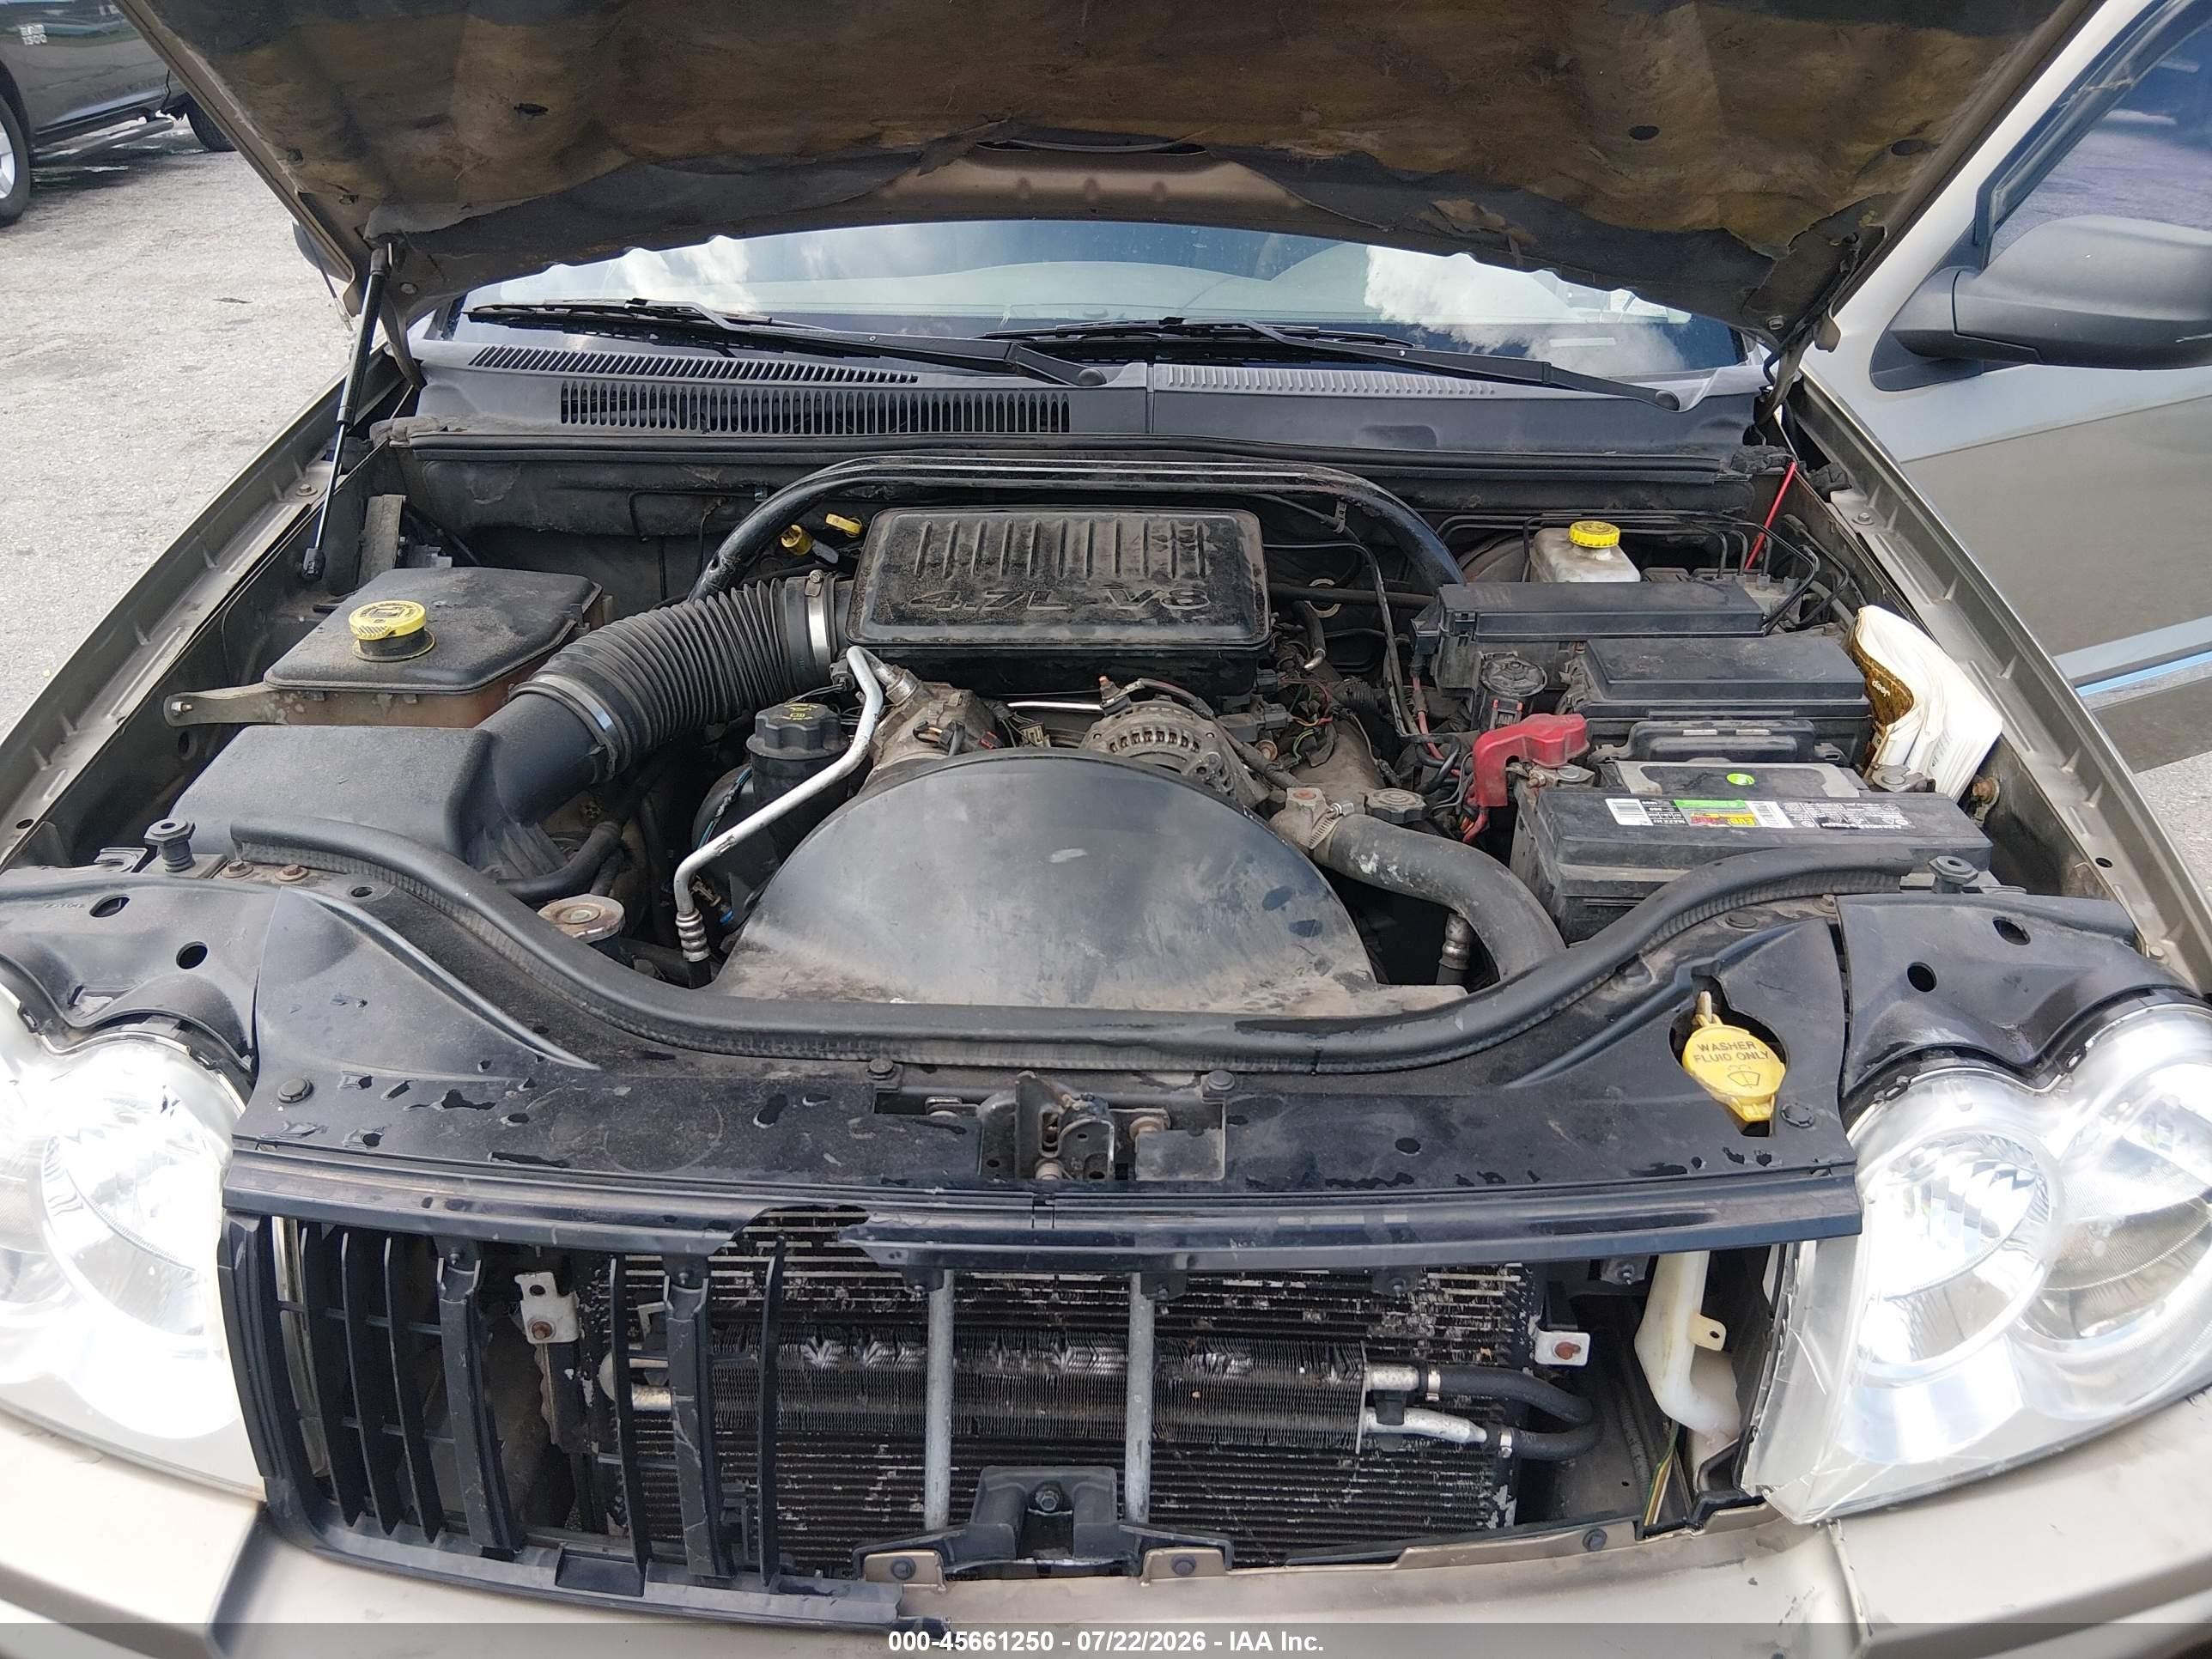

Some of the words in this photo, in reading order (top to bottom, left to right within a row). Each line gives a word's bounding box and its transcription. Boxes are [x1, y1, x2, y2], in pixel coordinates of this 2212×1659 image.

[22, 33, 47, 45] 1500
[908, 590, 1070, 611] 4.7L
[1099, 586, 1211, 611] V8
[1871, 678, 1891, 697] Jeep
[1698, 1042, 1757, 1052] WASHER
[1694, 1053, 1732, 1064] FLUID
[1736, 1050, 1769, 1061] ONLY
